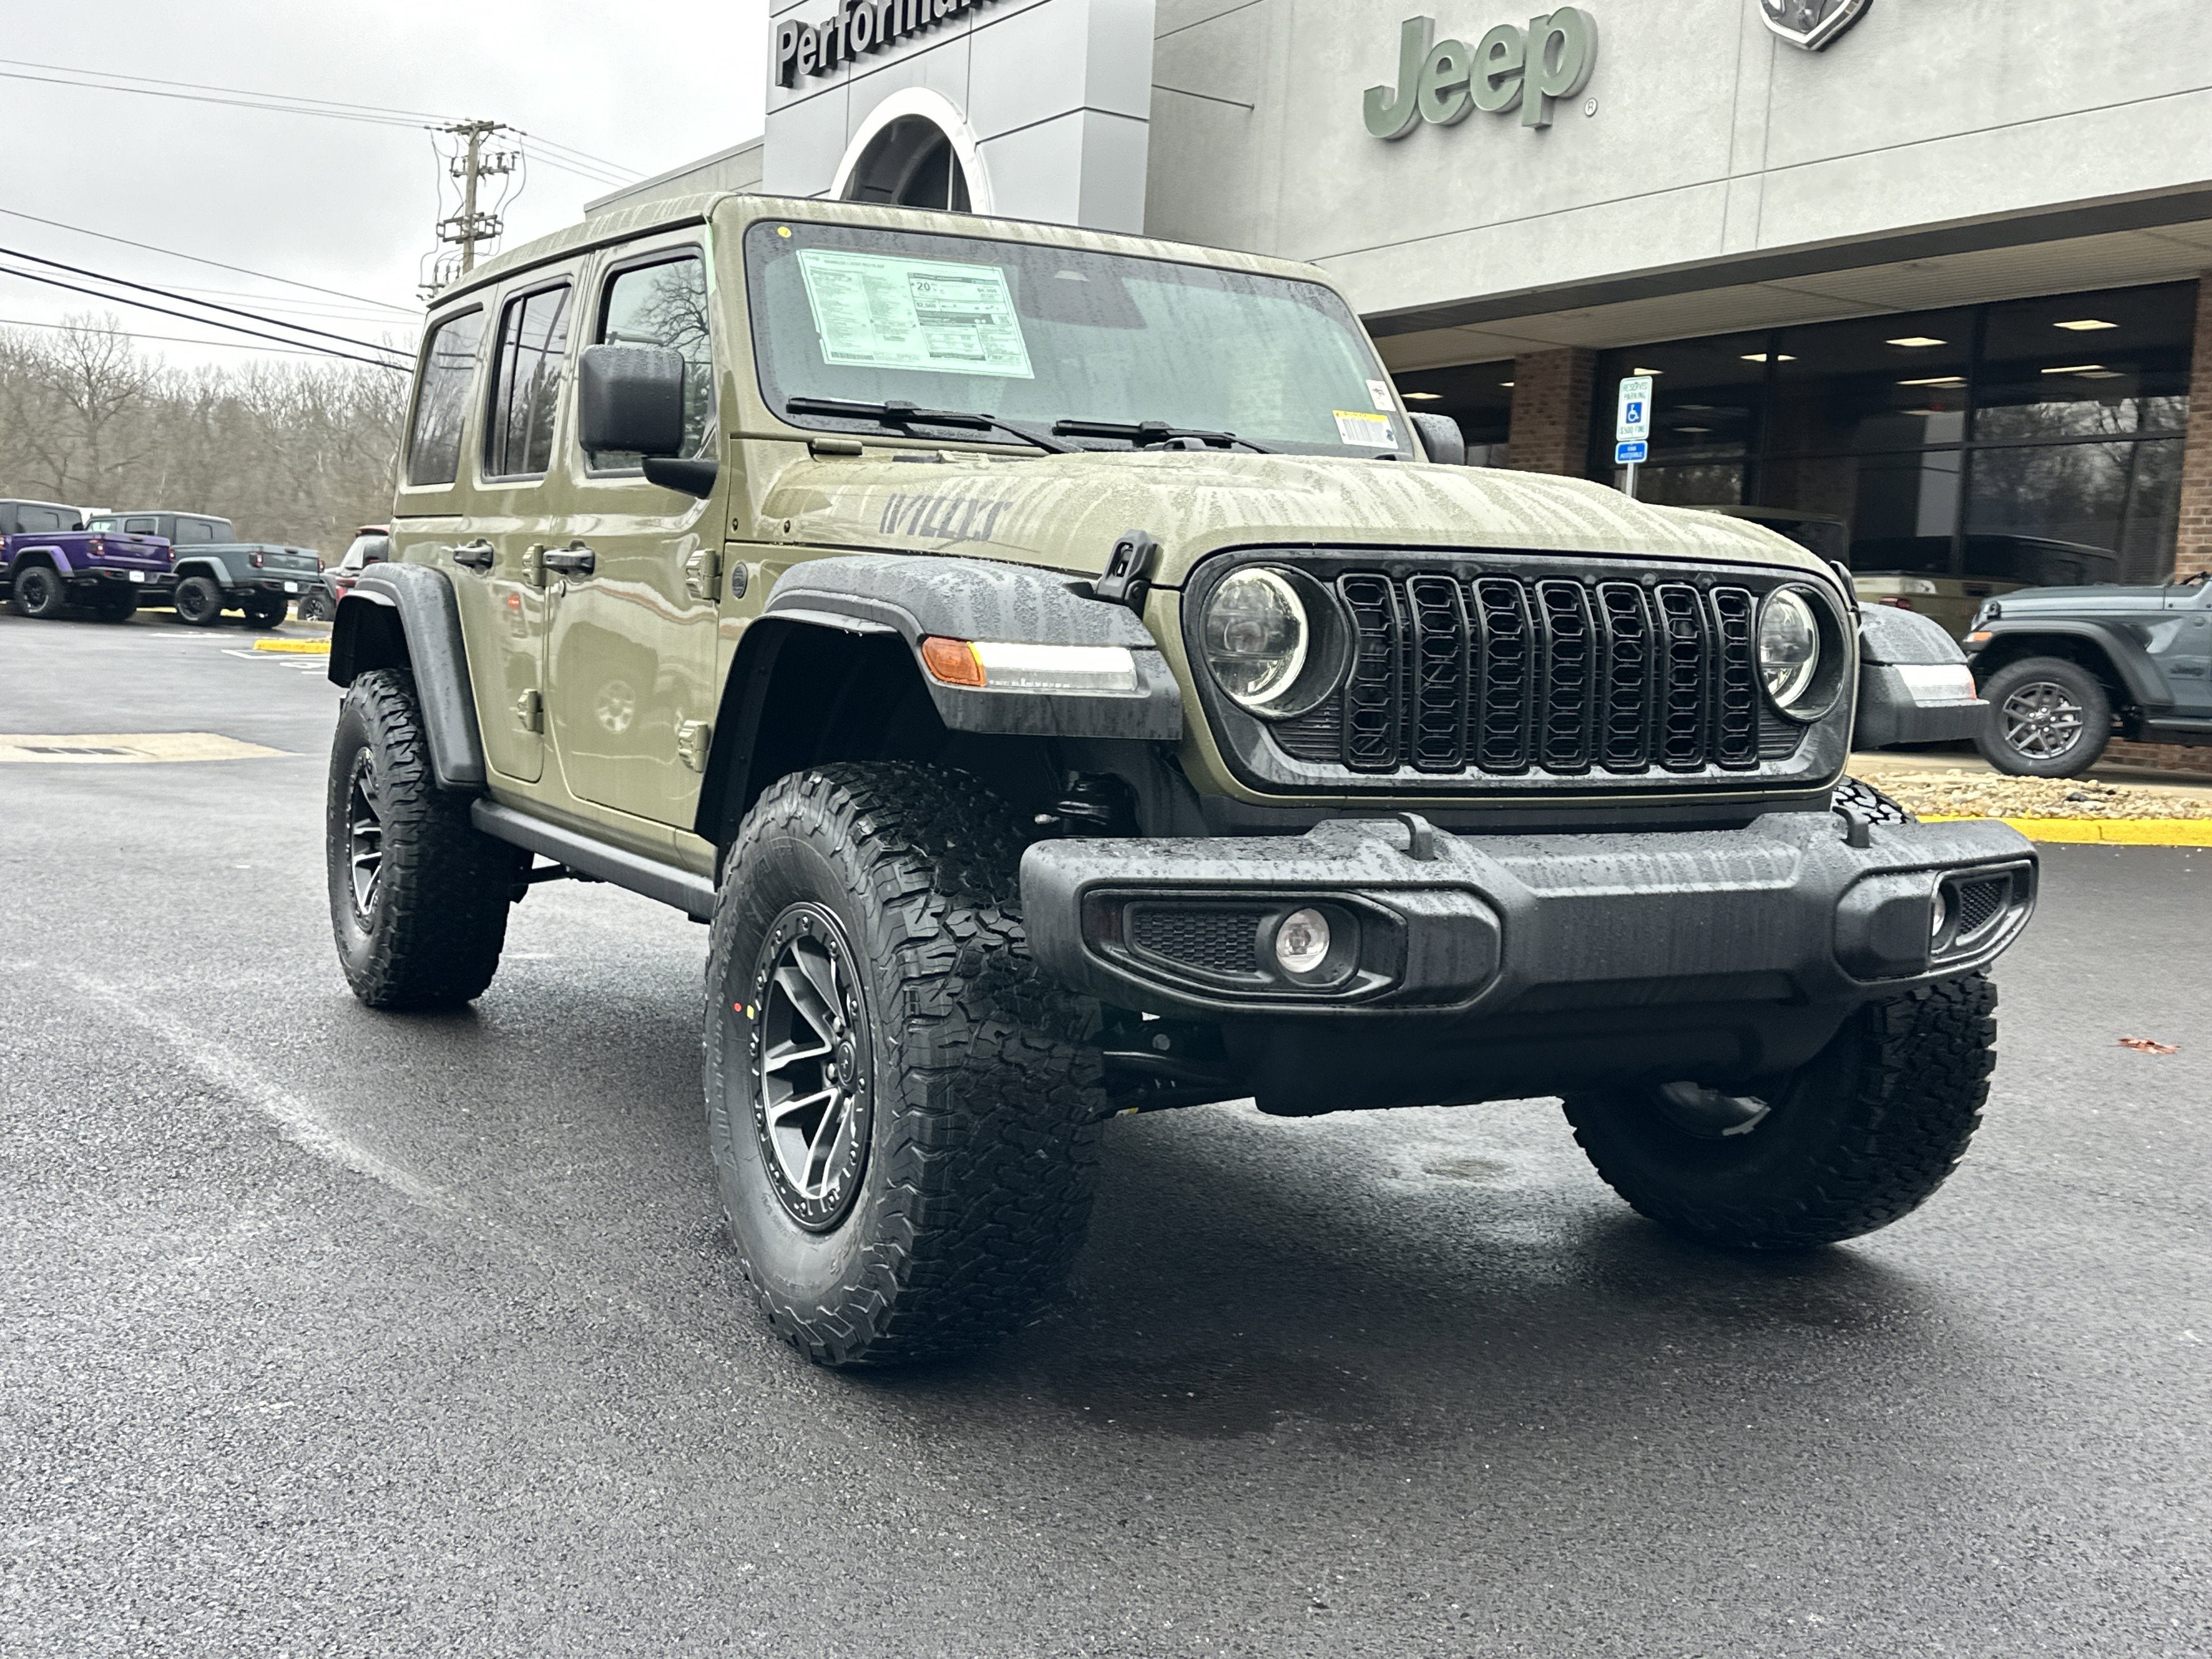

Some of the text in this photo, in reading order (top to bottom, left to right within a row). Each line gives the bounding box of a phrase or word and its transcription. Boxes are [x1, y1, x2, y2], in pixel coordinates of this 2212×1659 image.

[775, 0, 971, 87] Perform
[1363, 6, 1598, 139] Jeep
[879, 493, 1013, 541] WILLYS
